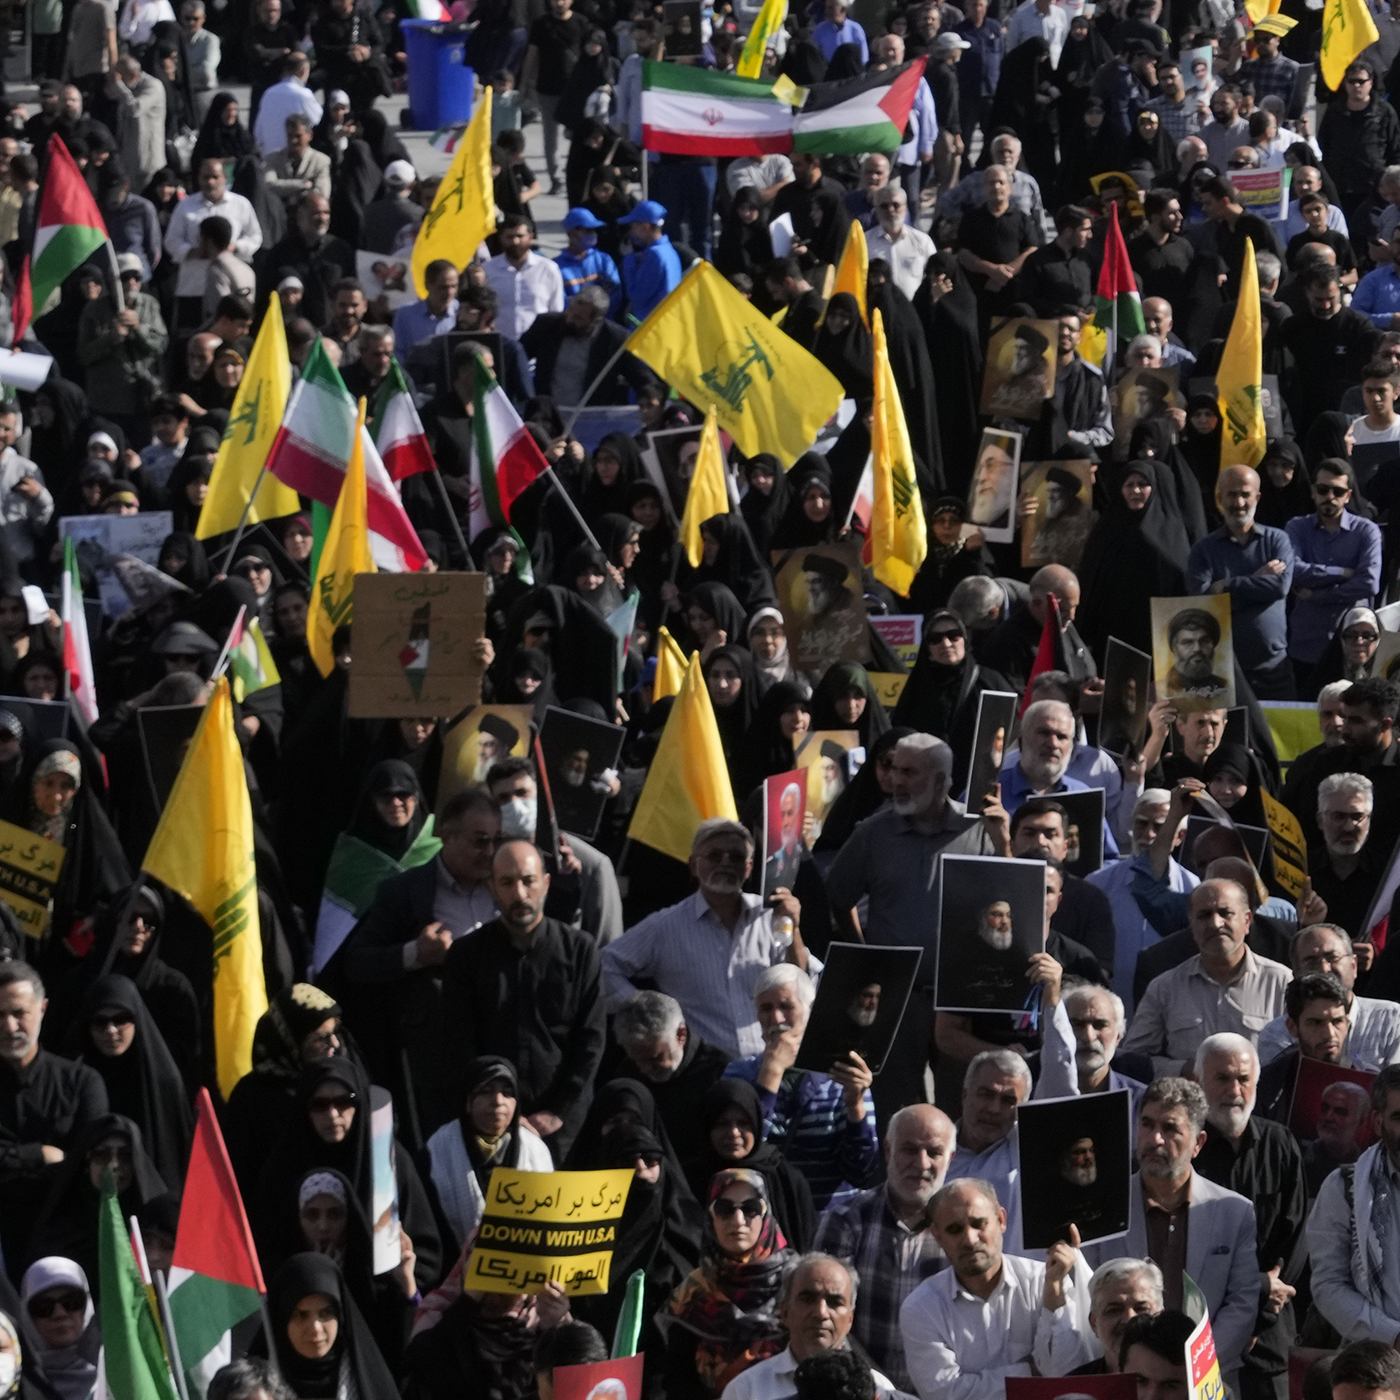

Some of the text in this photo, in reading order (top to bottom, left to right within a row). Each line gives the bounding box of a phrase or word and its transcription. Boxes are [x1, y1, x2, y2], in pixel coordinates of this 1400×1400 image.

[495, 1181, 622, 1216] مرگ بر امریکا
[480, 1223, 542, 1245] DOWN
[546, 1229, 584, 1247] WITH
[565, 1258, 606, 1290] الموت
